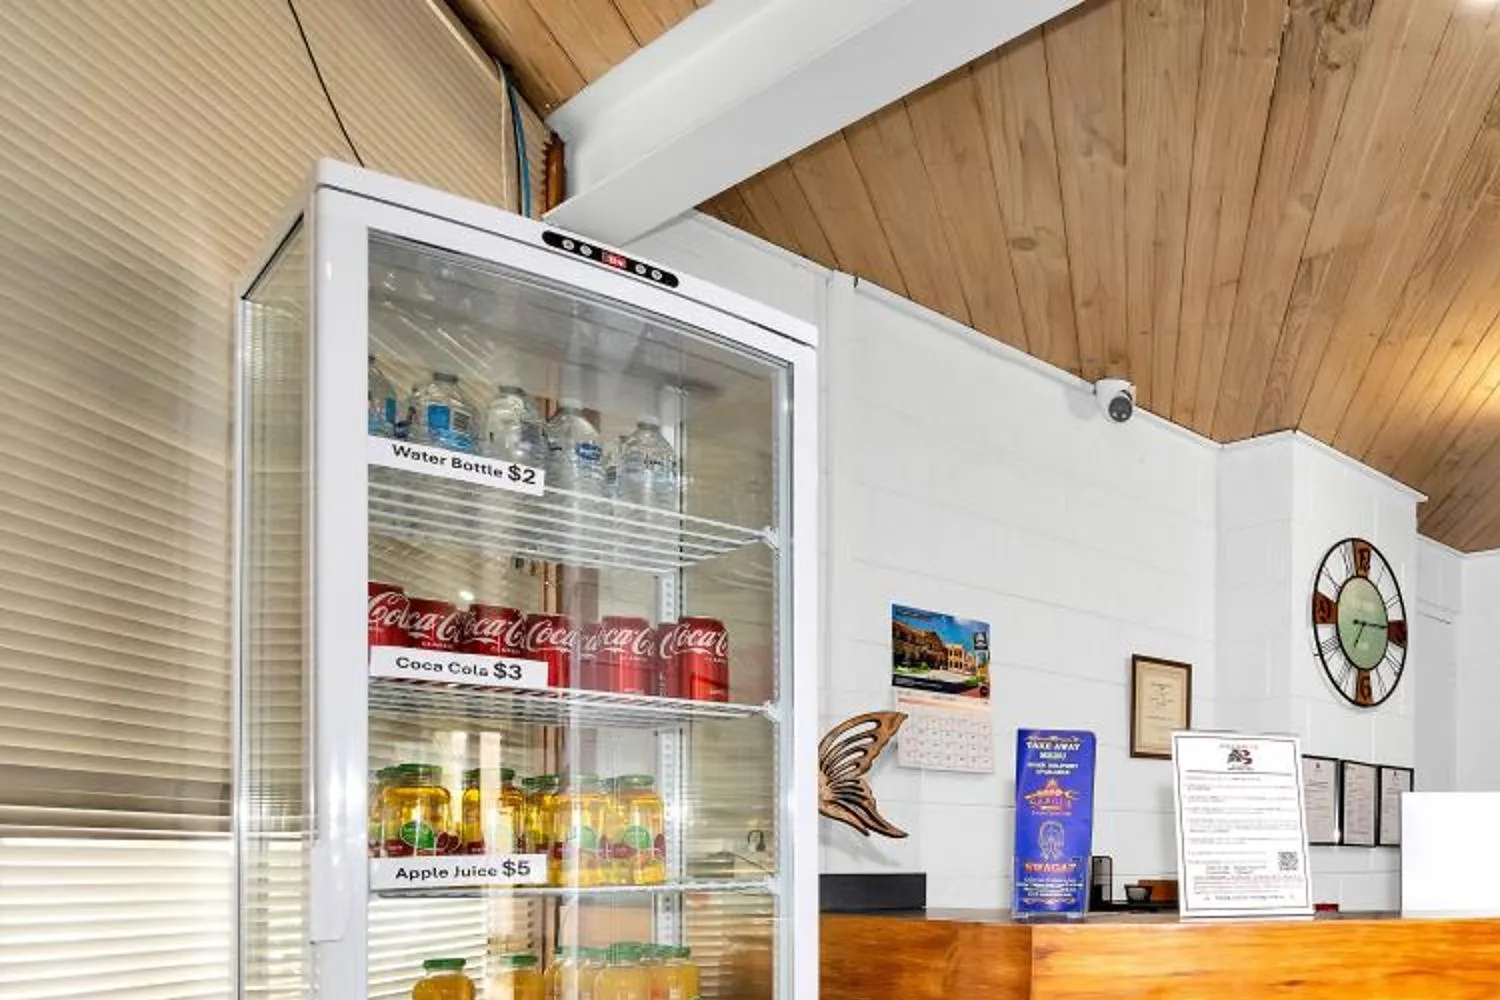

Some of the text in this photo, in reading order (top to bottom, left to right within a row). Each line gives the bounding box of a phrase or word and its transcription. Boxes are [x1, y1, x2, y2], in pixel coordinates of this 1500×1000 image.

[392, 444, 537, 486] Water Bottle $2
[395, 656, 523, 681] Coca Cola $3
[395, 858, 531, 881] Apple Juice $5
